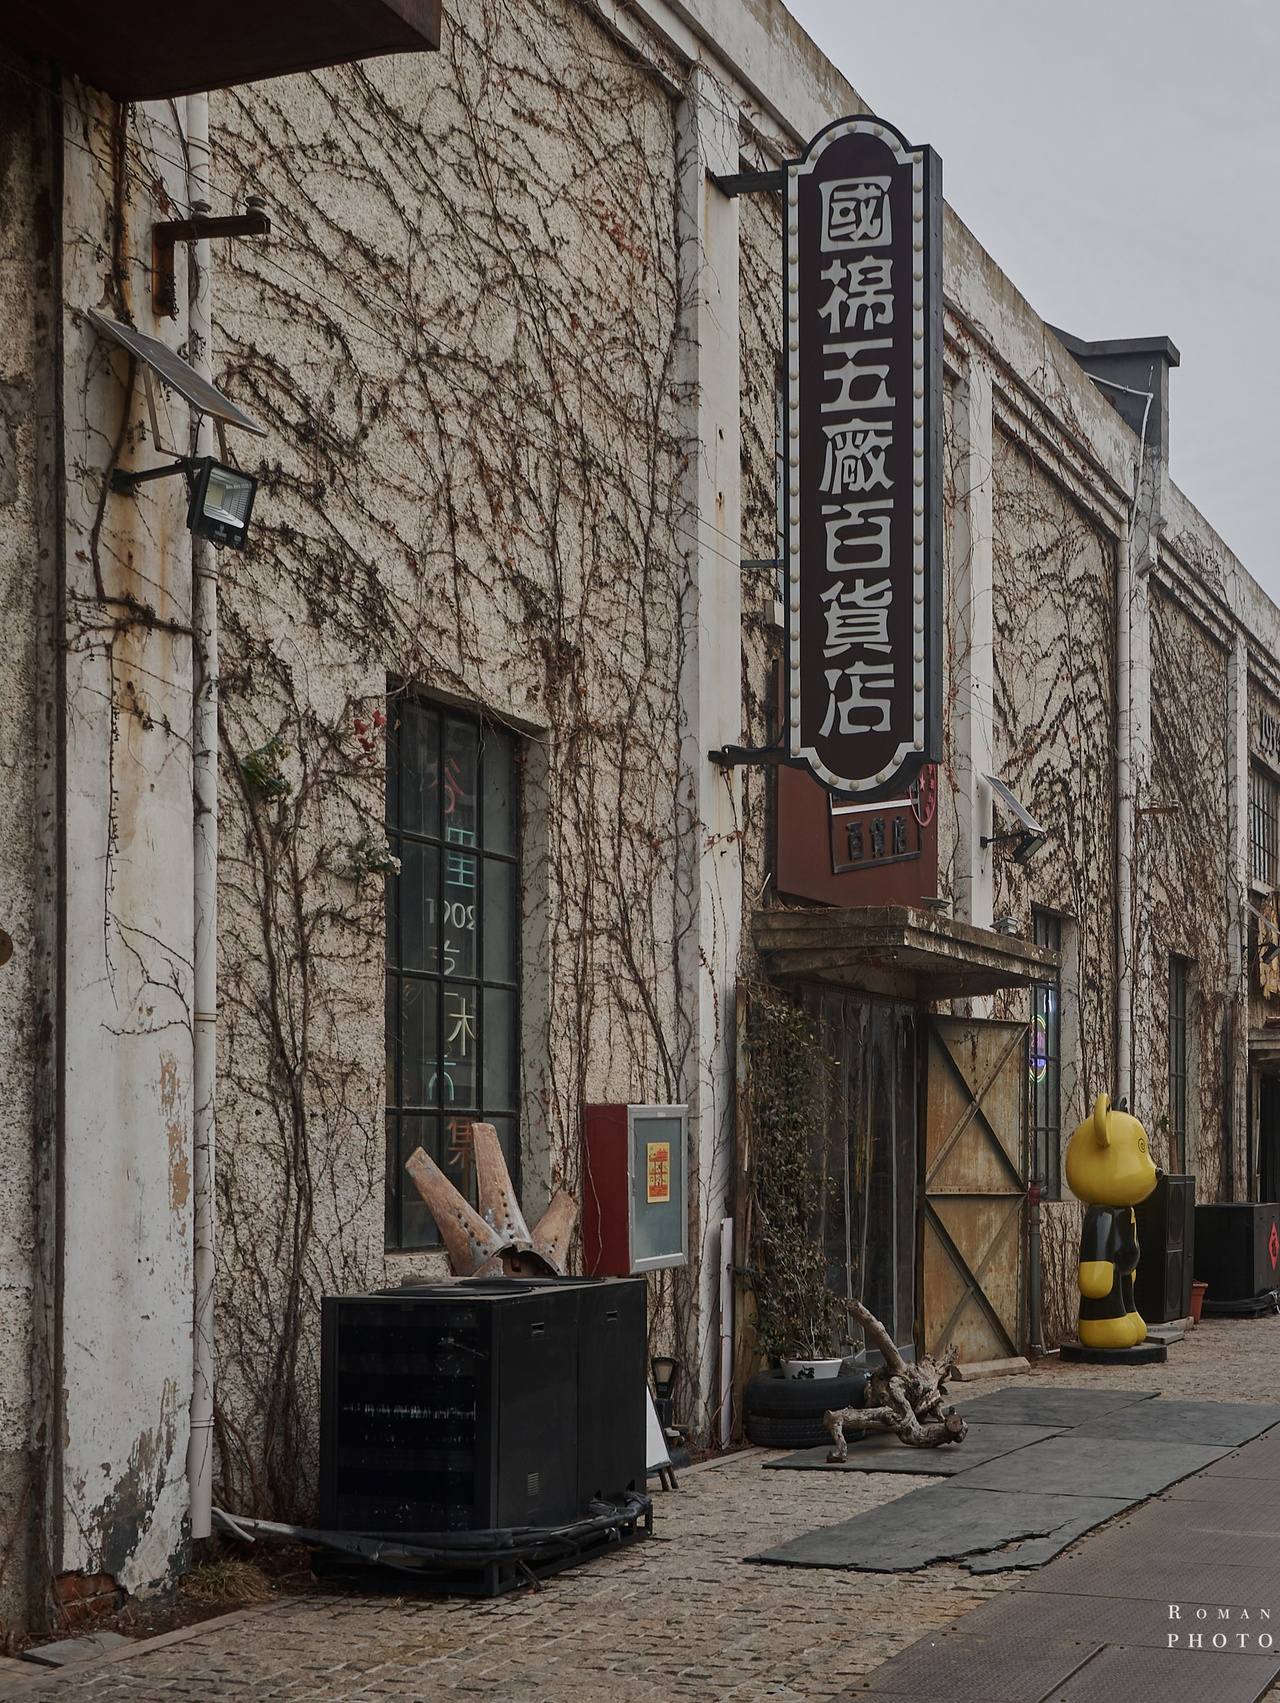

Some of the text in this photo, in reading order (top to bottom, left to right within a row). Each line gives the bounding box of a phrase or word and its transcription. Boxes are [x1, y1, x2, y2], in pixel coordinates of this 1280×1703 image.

[817, 175, 896, 738] 國棉五廠百貨店
